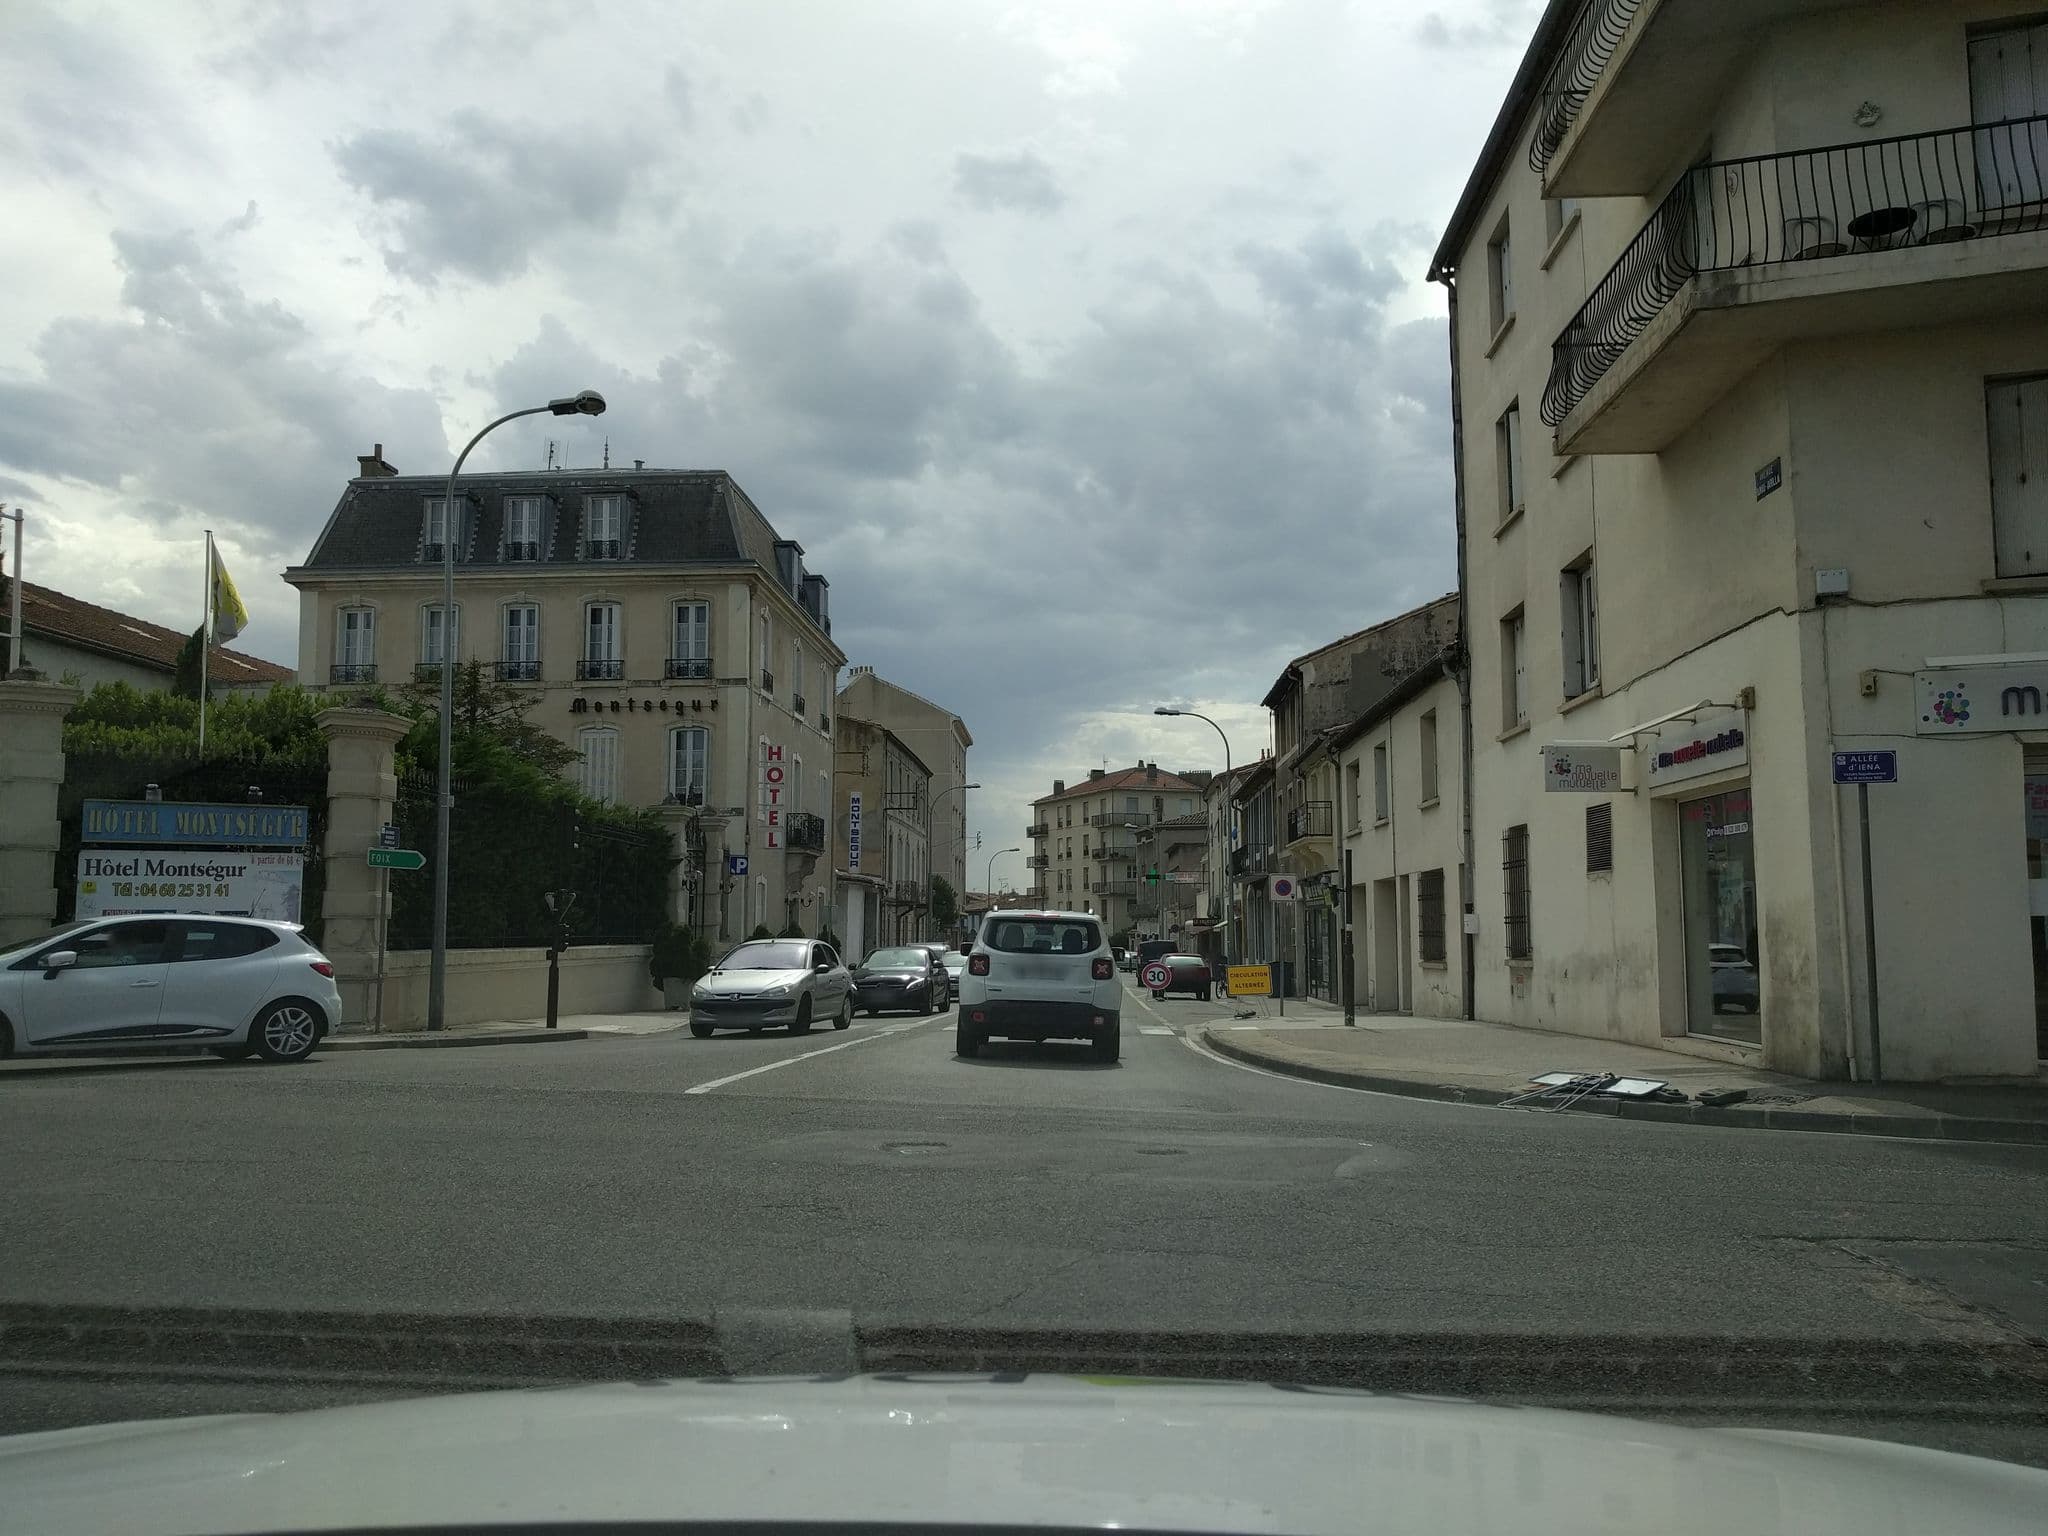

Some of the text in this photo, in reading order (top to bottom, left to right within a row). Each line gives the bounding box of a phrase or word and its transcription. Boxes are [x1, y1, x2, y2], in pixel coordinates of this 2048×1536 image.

[2002, 685, 2048, 716] m
[1575, 764, 1591, 773] ma
[767, 745, 784, 848] HOTEL
[88, 804, 161, 835] HÔTEL
[850, 796, 861, 868] MONTSEGUR
[371, 854, 391, 864] FOIX
[736, 858, 748, 874] P
[84, 858, 248, 882] Hôtel Montségur
[159, 883, 175, 897] 68
[178, 883, 194, 897] 25
[196, 883, 211, 897] 31
[214, 883, 230, 897] 41
[1148, 971, 1167, 982] 30
